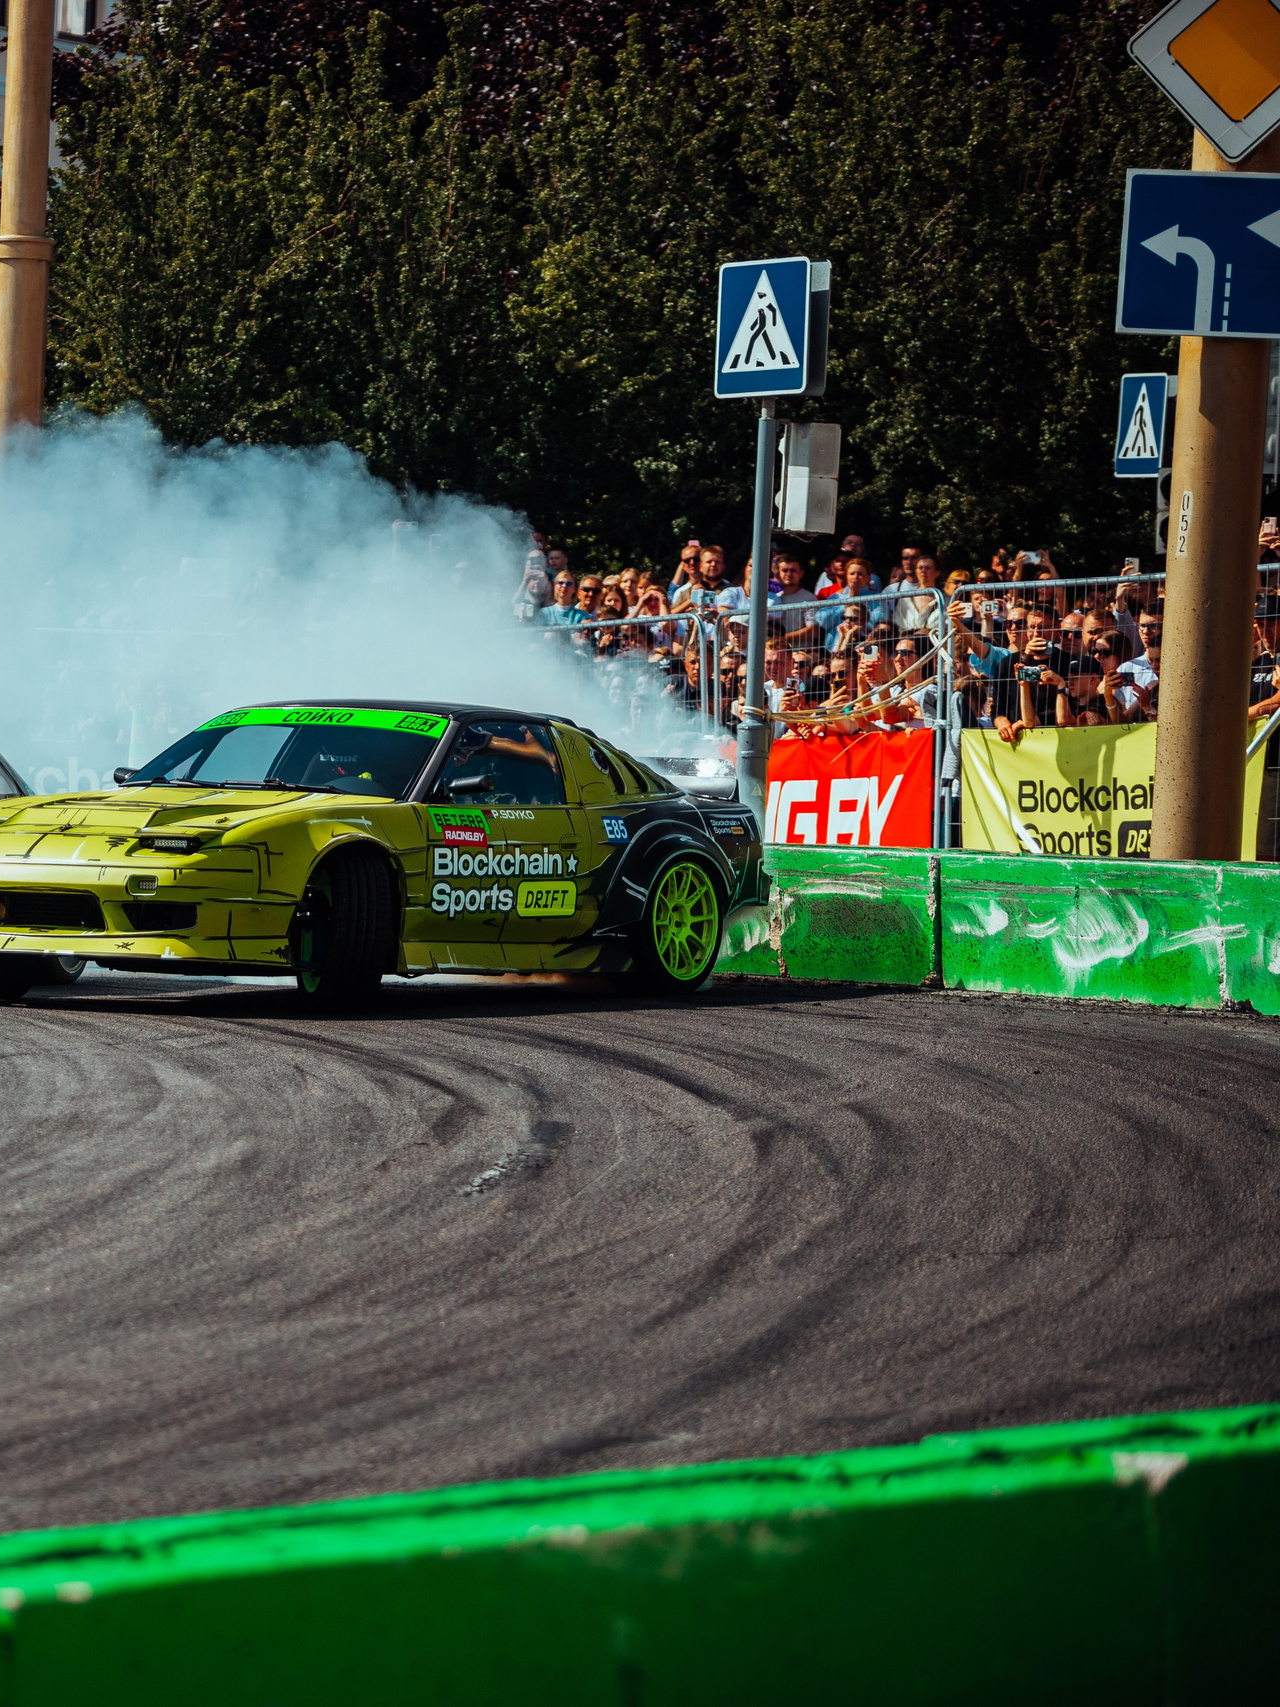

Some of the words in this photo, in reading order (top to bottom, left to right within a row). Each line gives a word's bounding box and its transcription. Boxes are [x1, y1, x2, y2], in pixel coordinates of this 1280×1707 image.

[282, 708, 355, 723] СОЙКО
[491, 810, 535, 820] P.SOYKO
[445, 830, 485, 842] RACING.BY
[603, 819, 628, 839] E85
[1017, 823, 1112, 856] Sports
[434, 847, 562, 876] Blockchain
[431, 882, 514, 918] Sports
[524, 889, 569, 909] DRIFT
